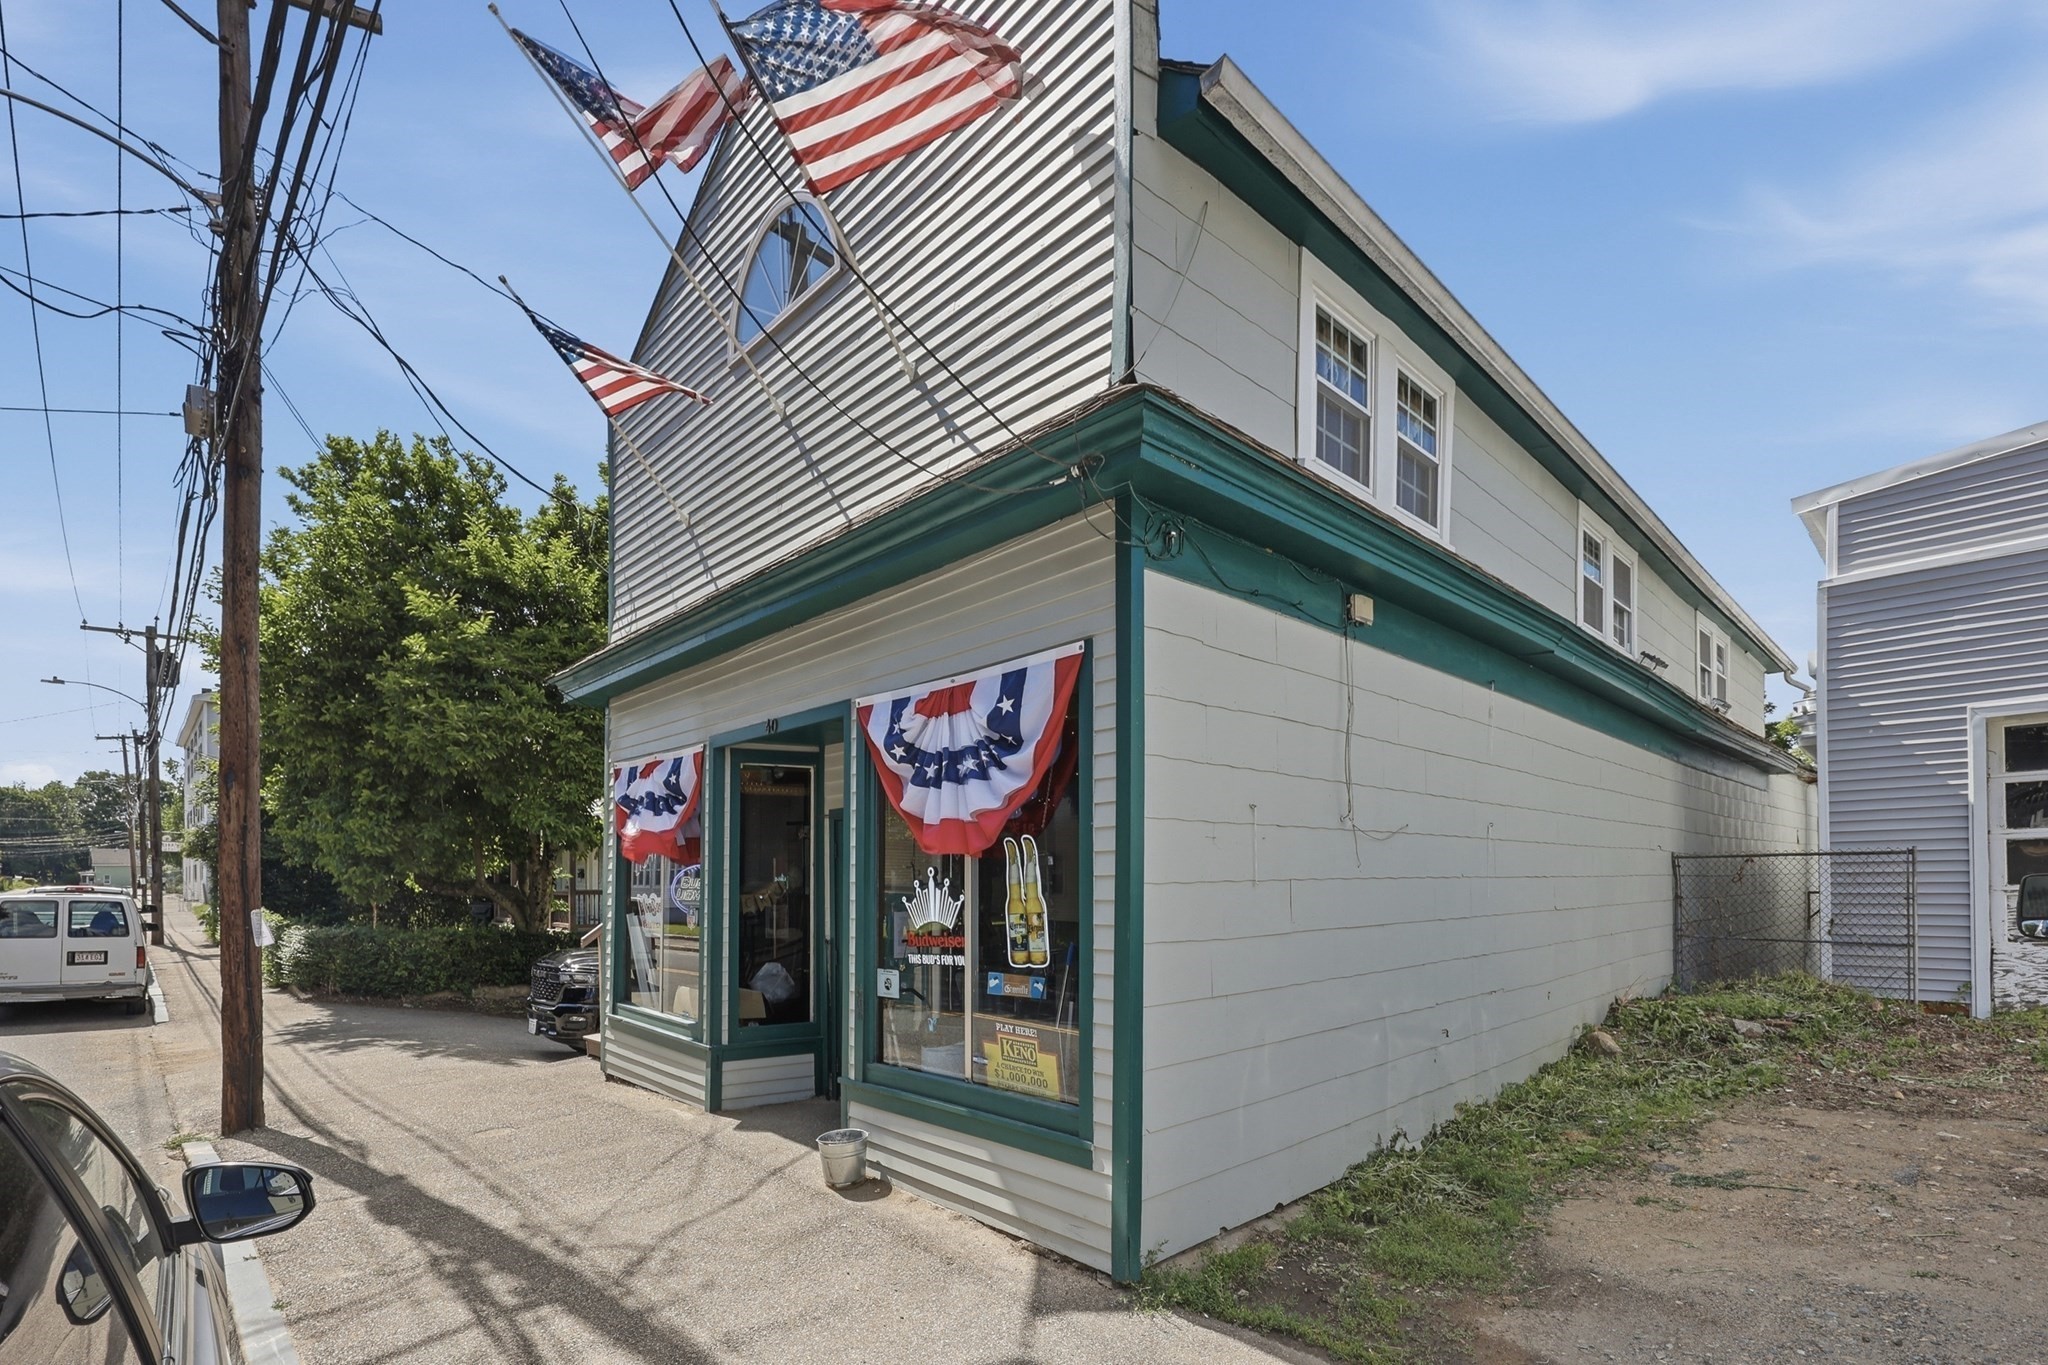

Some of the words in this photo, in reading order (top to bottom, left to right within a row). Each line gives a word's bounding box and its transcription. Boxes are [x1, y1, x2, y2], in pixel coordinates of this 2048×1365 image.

[765, 718, 779, 734] 40
[907, 932, 965, 947] Budweiser
[907, 953, 921, 964] THIS
[921, 954, 941, 965] BUD'S
[941, 954, 954, 966] FOR
[995, 1022, 1014, 1034] PLAY
[1015, 1026, 1038, 1037] HERE!
[1001, 1038, 1036, 1062] KENO
[1001, 1062, 1024, 1073] CHANCE
[1024, 1067, 1032, 1075] TO
[1033, 1069, 1045, 1077] WIN
[994, 1068, 1049, 1089] $1,000,000
